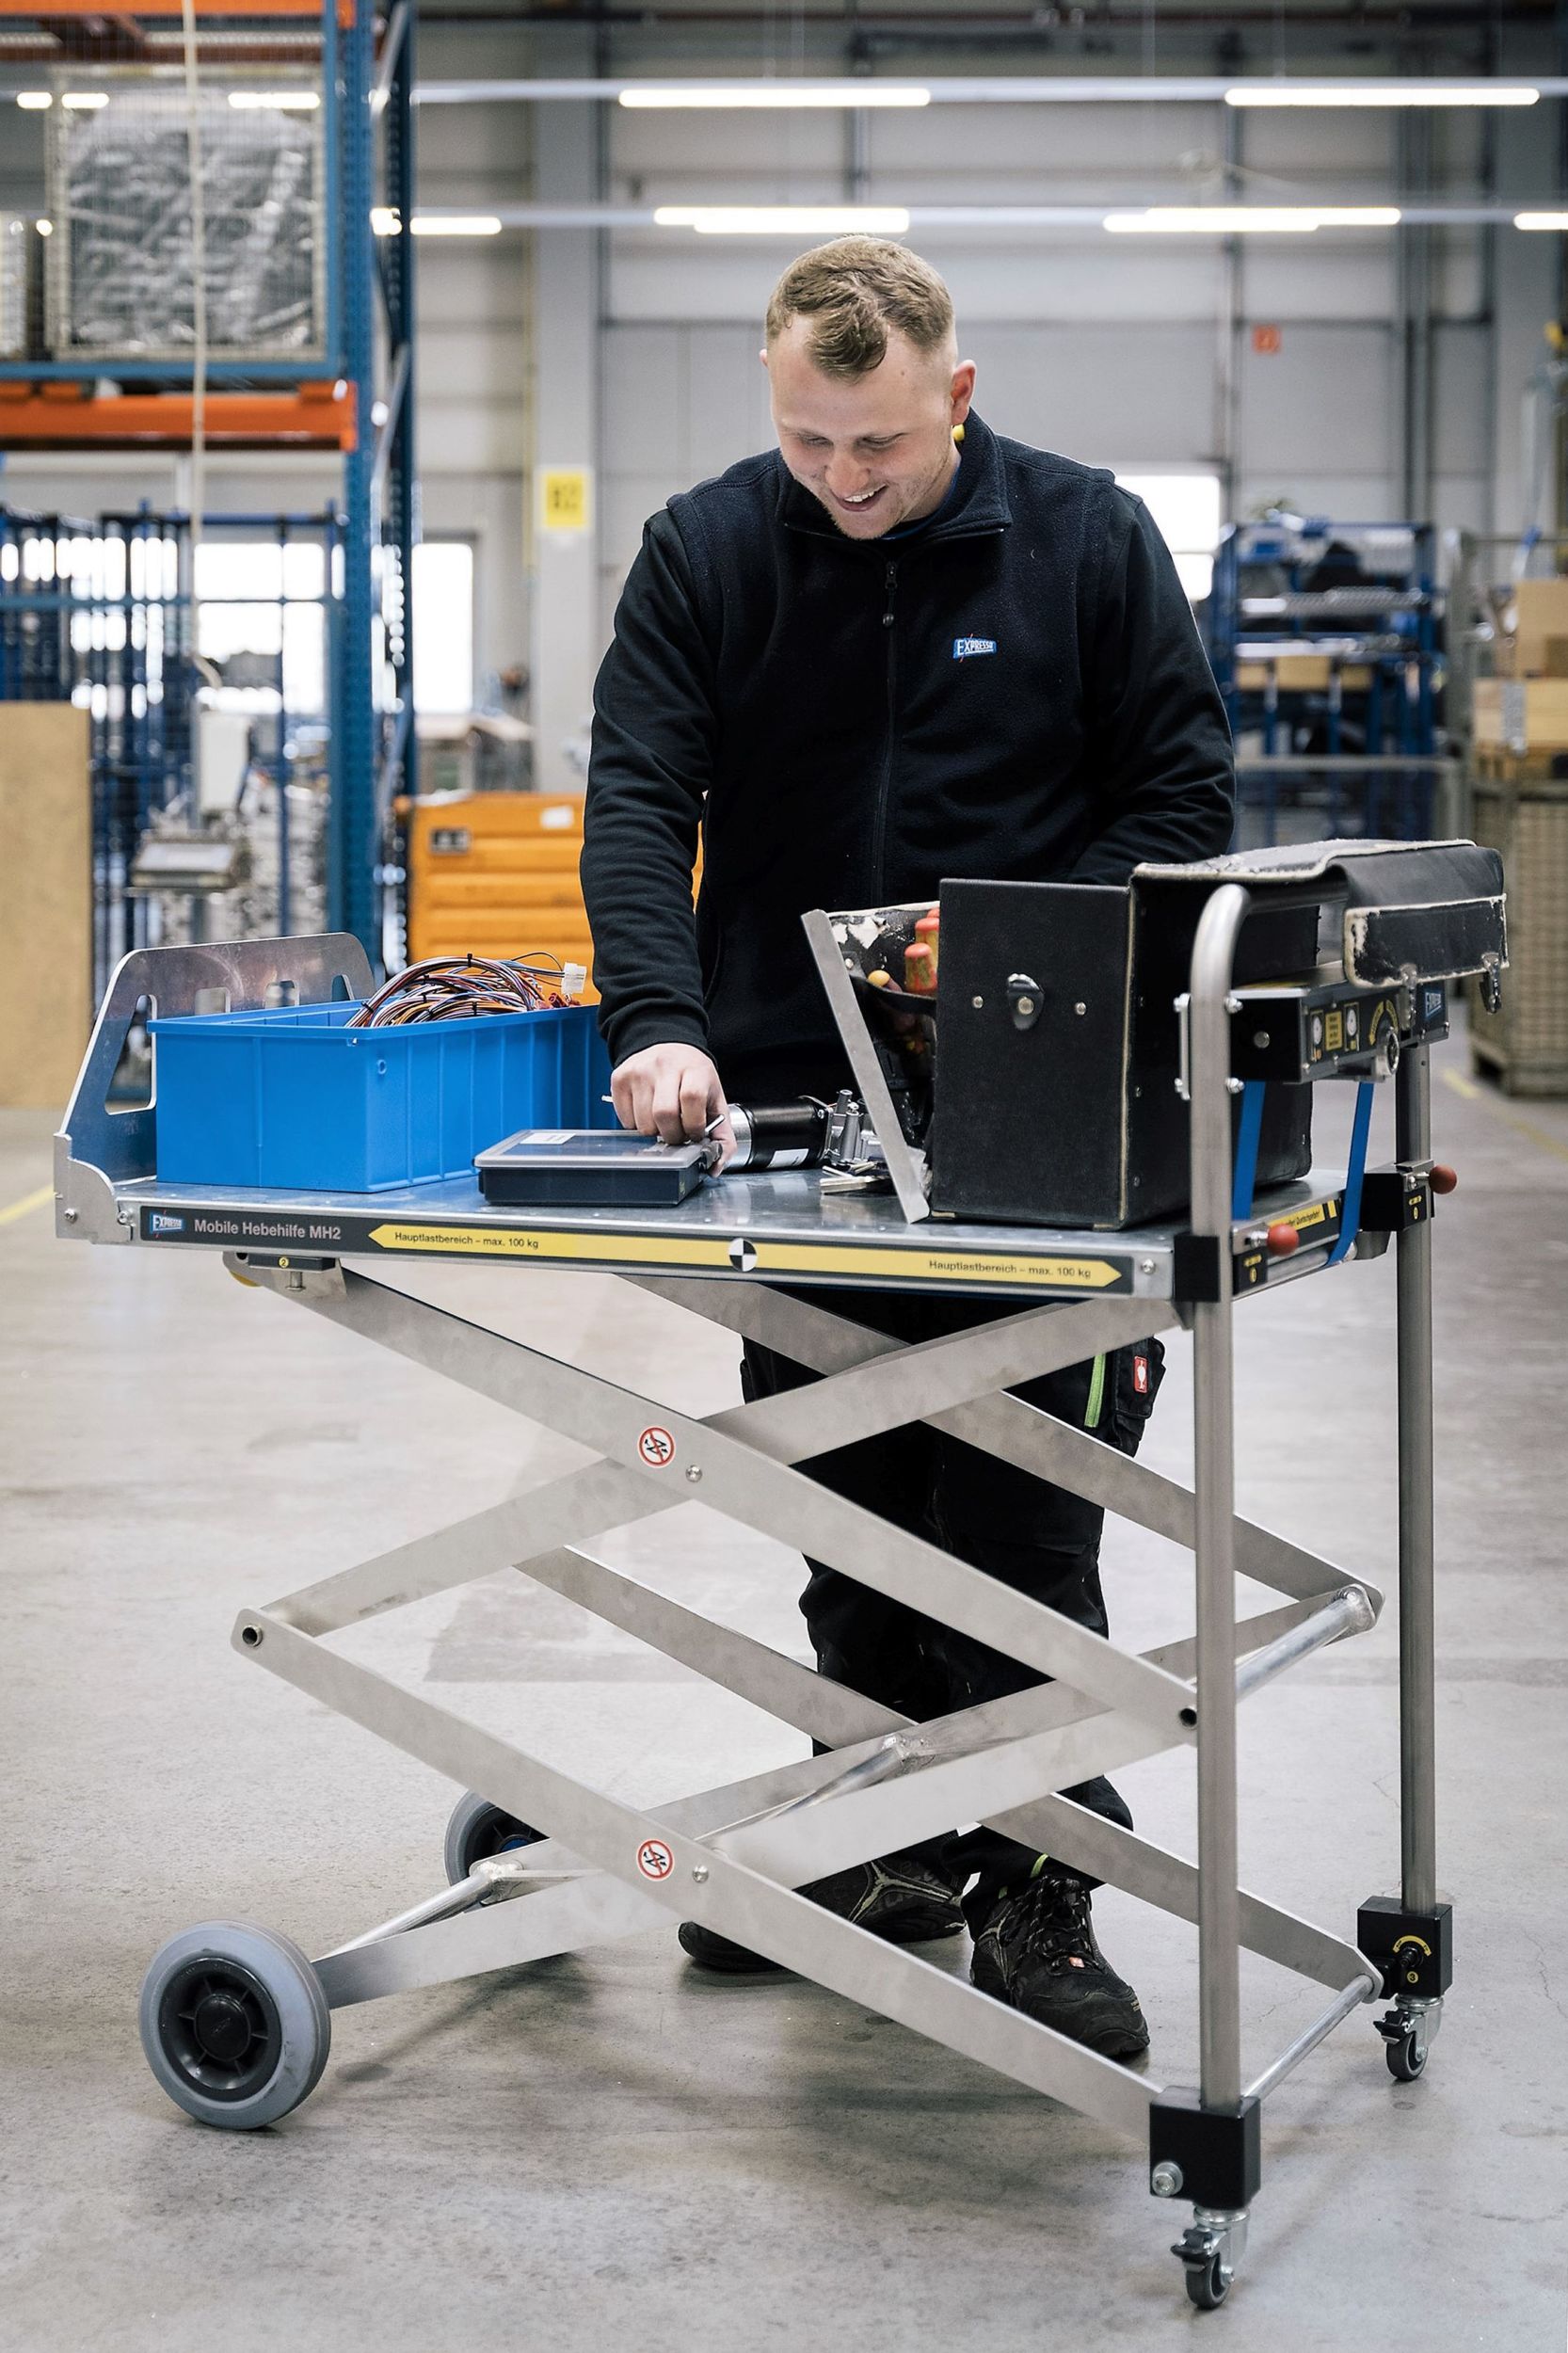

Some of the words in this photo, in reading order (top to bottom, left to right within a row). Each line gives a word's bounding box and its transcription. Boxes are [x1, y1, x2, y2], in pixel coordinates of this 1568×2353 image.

[194, 1219, 239, 1234] Mobile
[242, 1222, 306, 1239] Hebehilfe
[309, 1225, 342, 1241] MH2
[395, 1232, 473, 1245] Hauptlastbereich
[483, 1238, 505, 1246] max.
[508, 1238, 524, 1247] 100
[526, 1239, 539, 1249] kg
[929, 1259, 1017, 1273] Hauptlastbereich
[1028, 1266, 1053, 1276] max.
[1057, 1267, 1075, 1277] 100
[1078, 1268, 1091, 1279] kg
